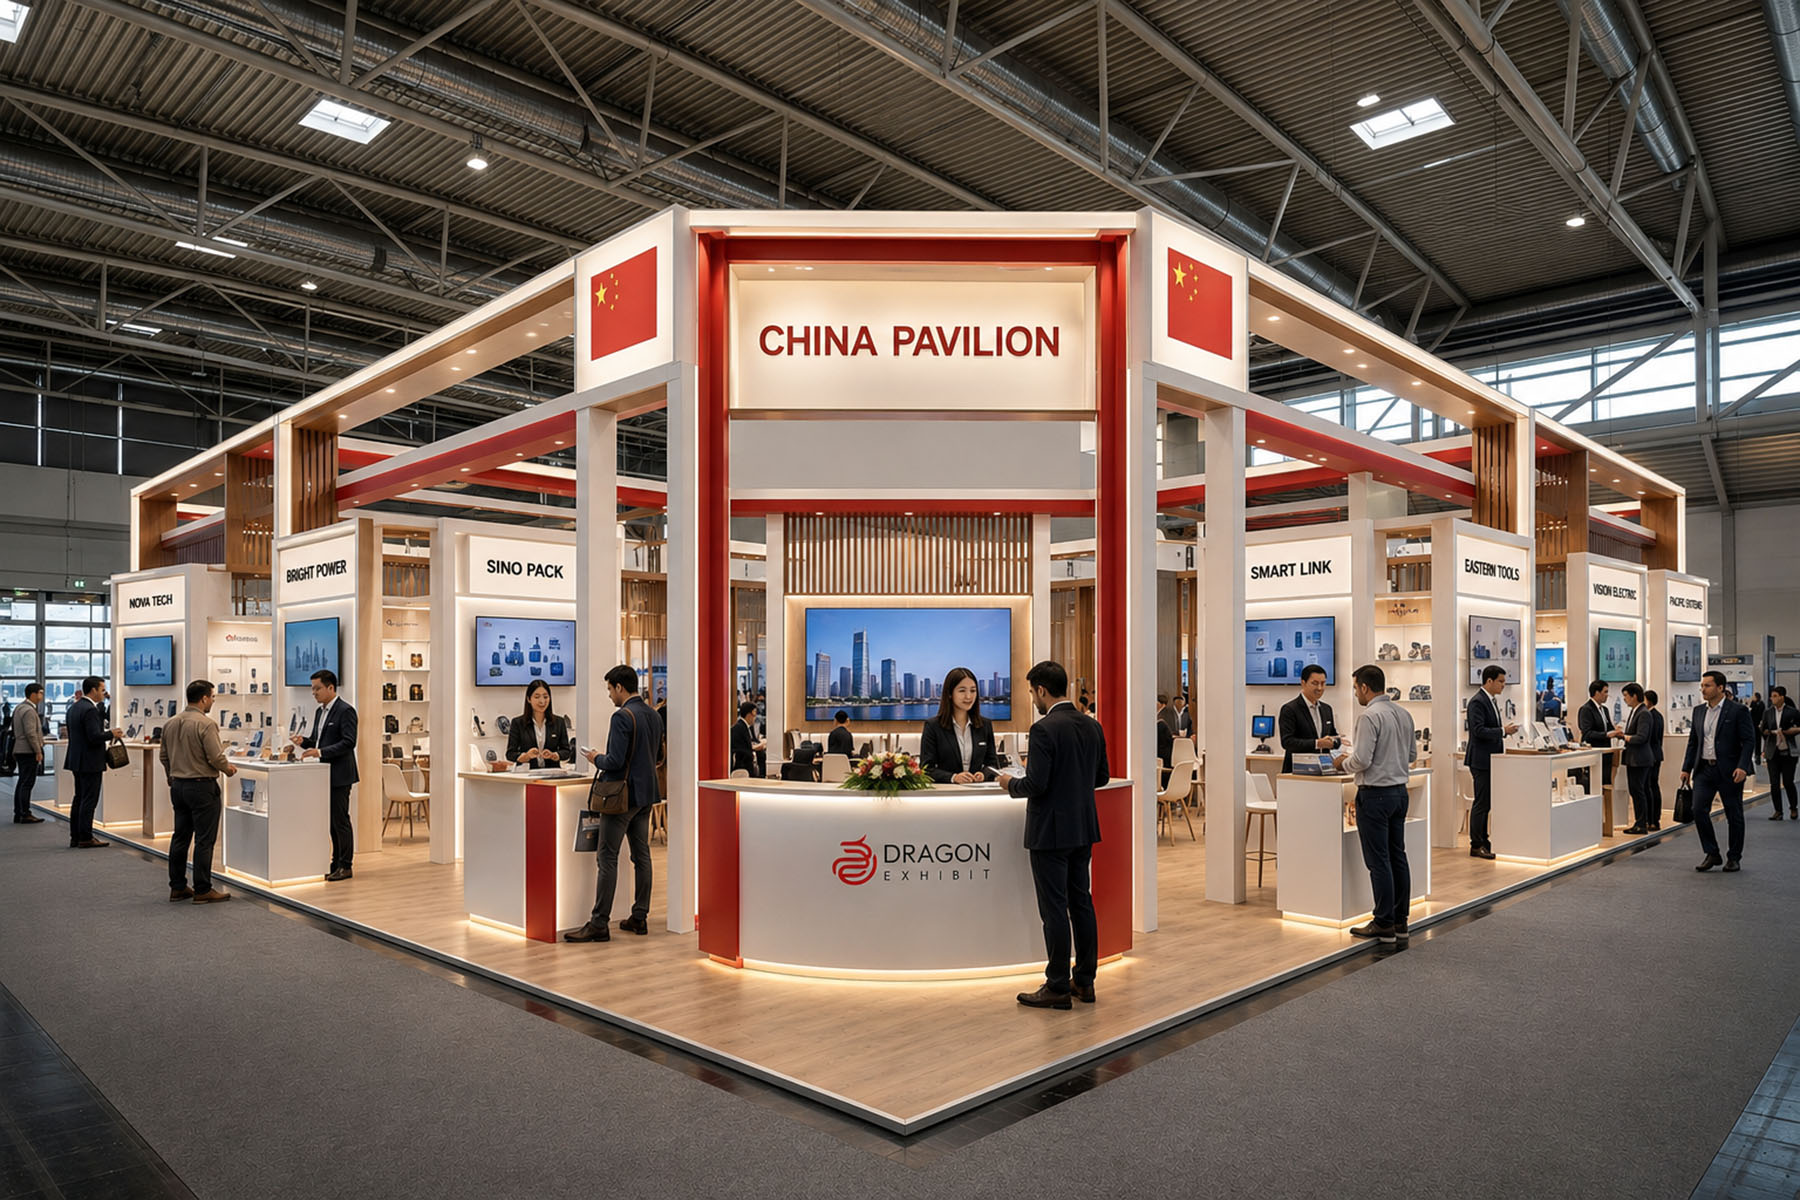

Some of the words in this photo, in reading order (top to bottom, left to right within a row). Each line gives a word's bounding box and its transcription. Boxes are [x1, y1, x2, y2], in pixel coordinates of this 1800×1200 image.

[759, 325, 878, 356] CHINA
[893, 325, 1059, 357] PAVILION
[286, 565, 315, 583] BRIGHT
[316, 559, 347, 578] POWER
[487, 559, 523, 576] SINO
[527, 562, 564, 579] PACK
[1250, 563, 1297, 580] SMART
[1300, 559, 1332, 576] LINK
[1465, 558, 1496, 577] EASTERN
[1497, 564, 1520, 581] TOOLS
[1592, 583, 1612, 596] VISION
[129, 596, 150, 609] NOVA
[152, 593, 173, 607] TECH
[884, 842, 990, 864] DRAGON
[884, 869, 990, 881] EXHIBIT
